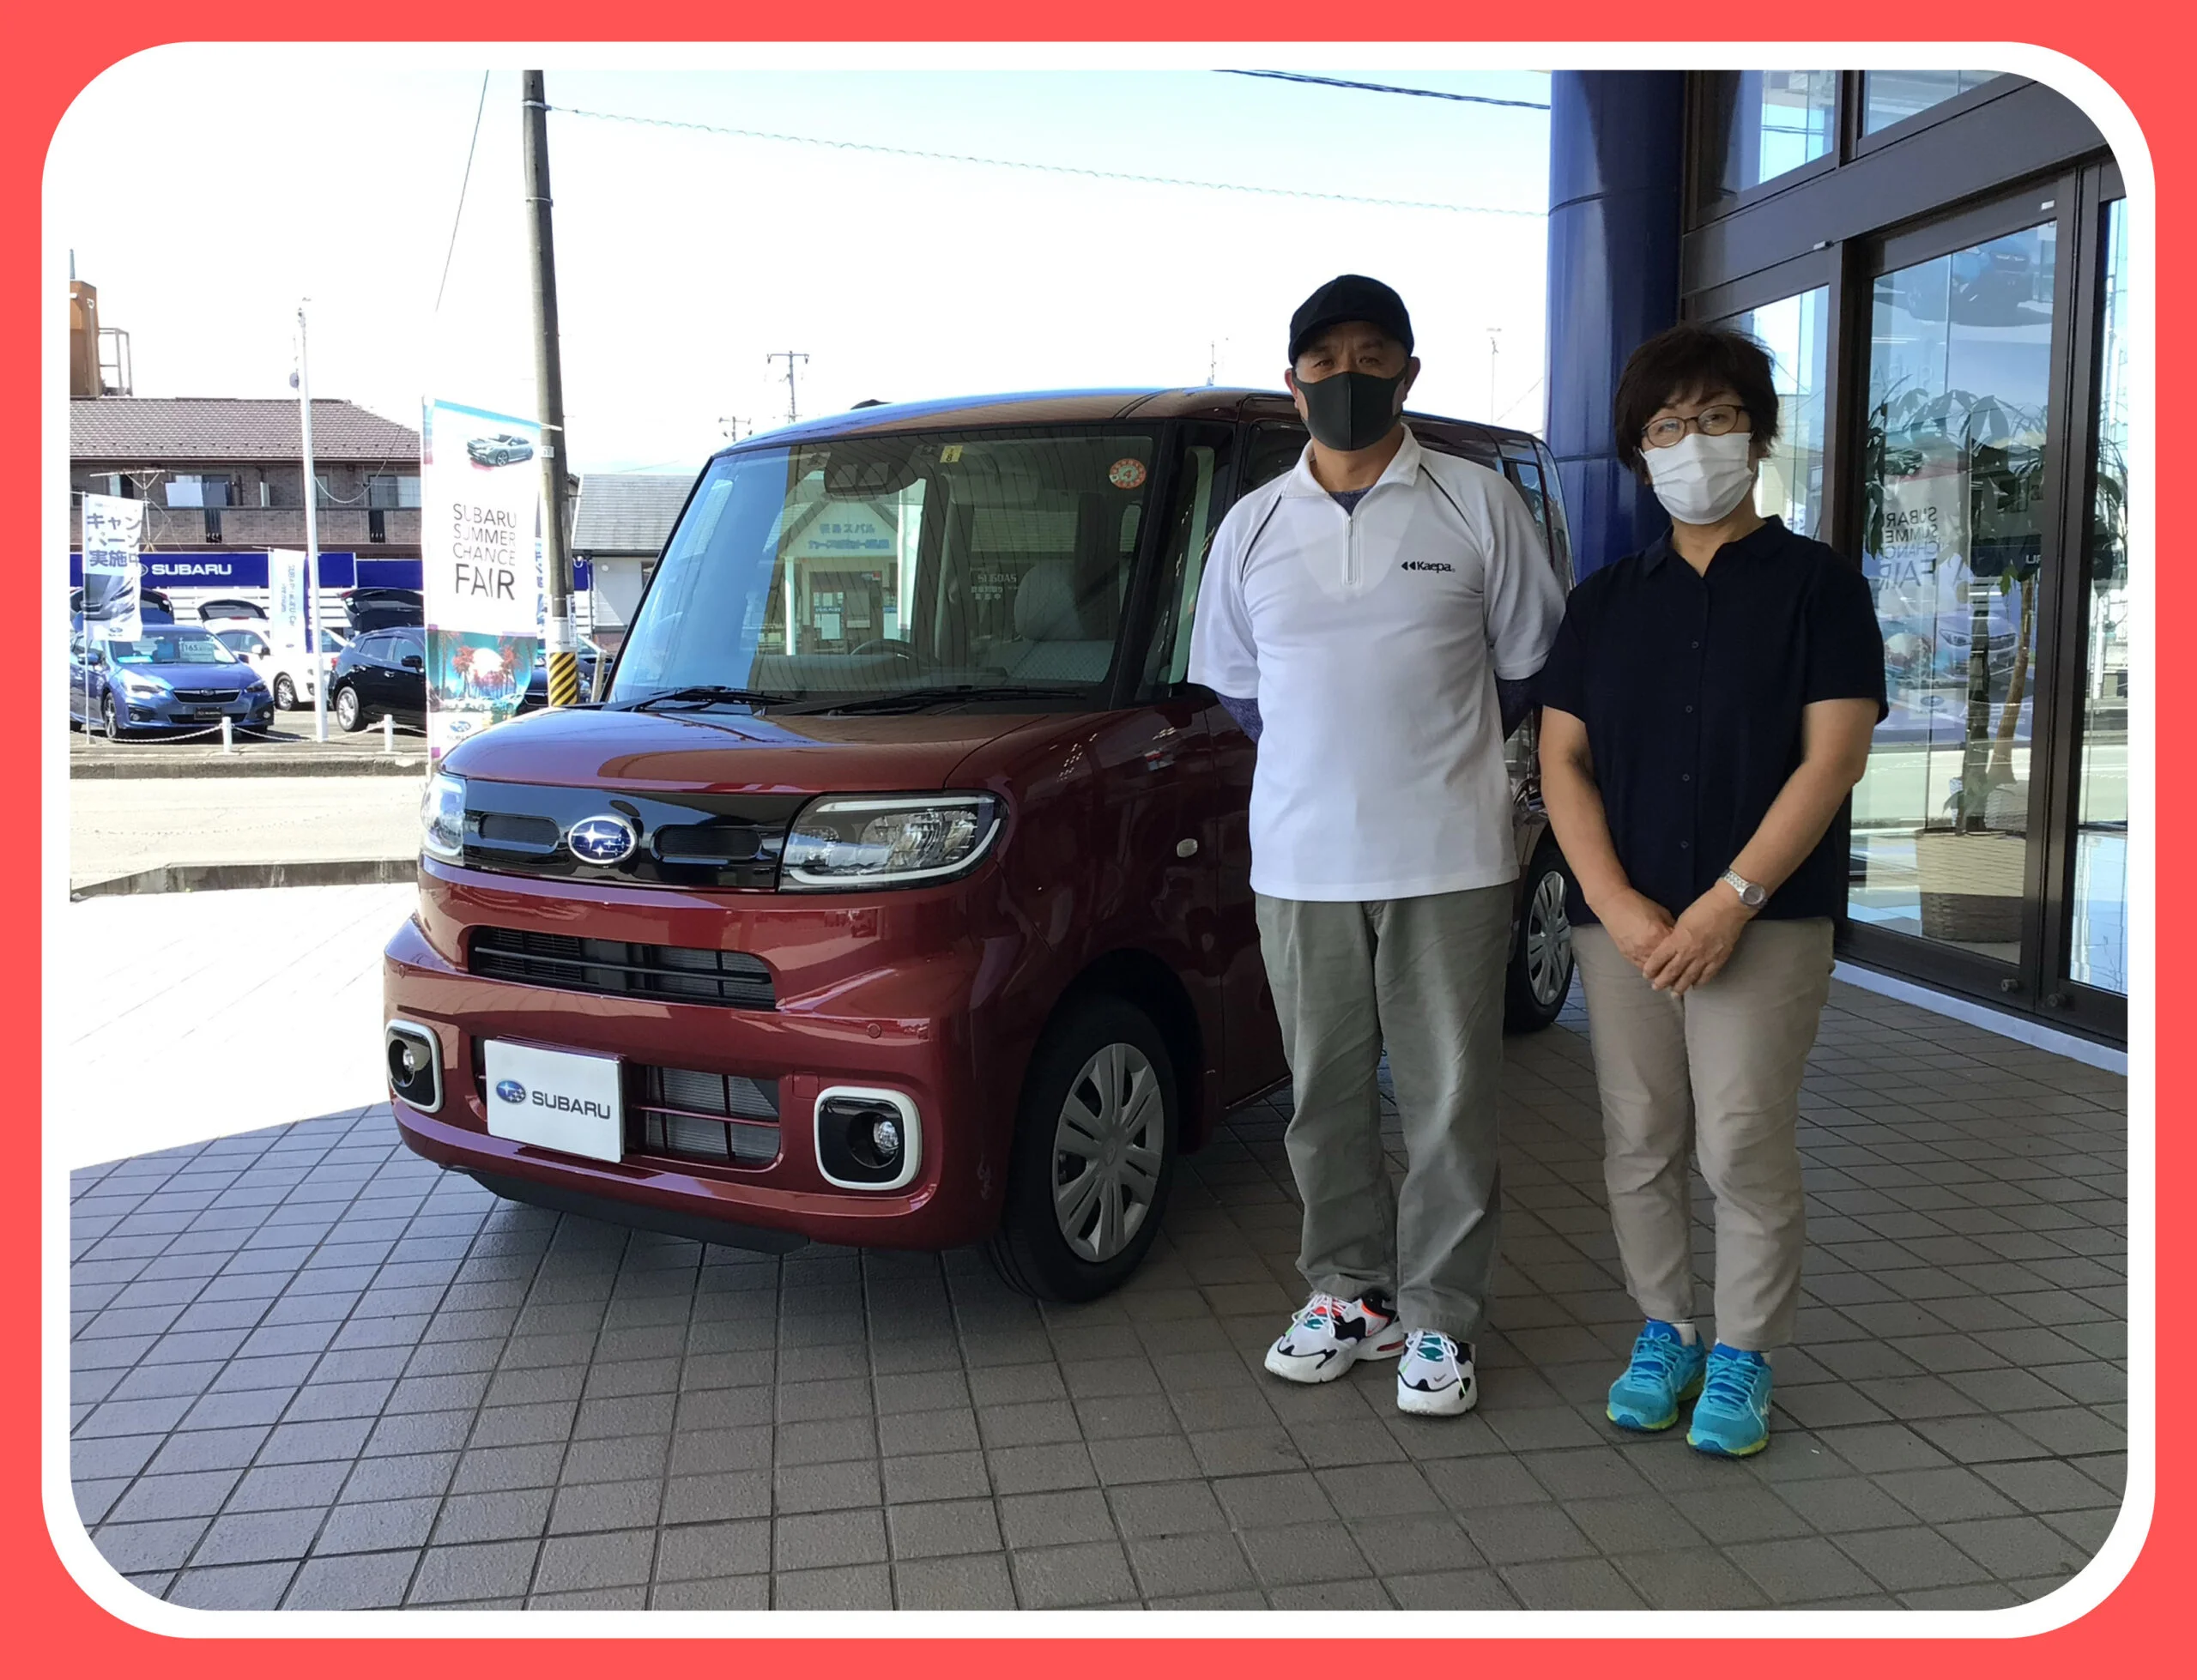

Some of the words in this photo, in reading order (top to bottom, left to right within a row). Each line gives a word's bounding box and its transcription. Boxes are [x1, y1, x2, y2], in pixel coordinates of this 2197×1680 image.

[87, 512, 142, 530] キャン
[453, 503, 516, 528] SUBARU
[453, 523, 515, 547] SUMMER
[88, 549, 140, 568] 実施中
[453, 542, 515, 566] CHANCE
[151, 564, 232, 575] SUBARU
[1416, 560, 1452, 573] Kaepa
[456, 563, 515, 601] FAIR
[532, 1091, 611, 1120] SUBARU
